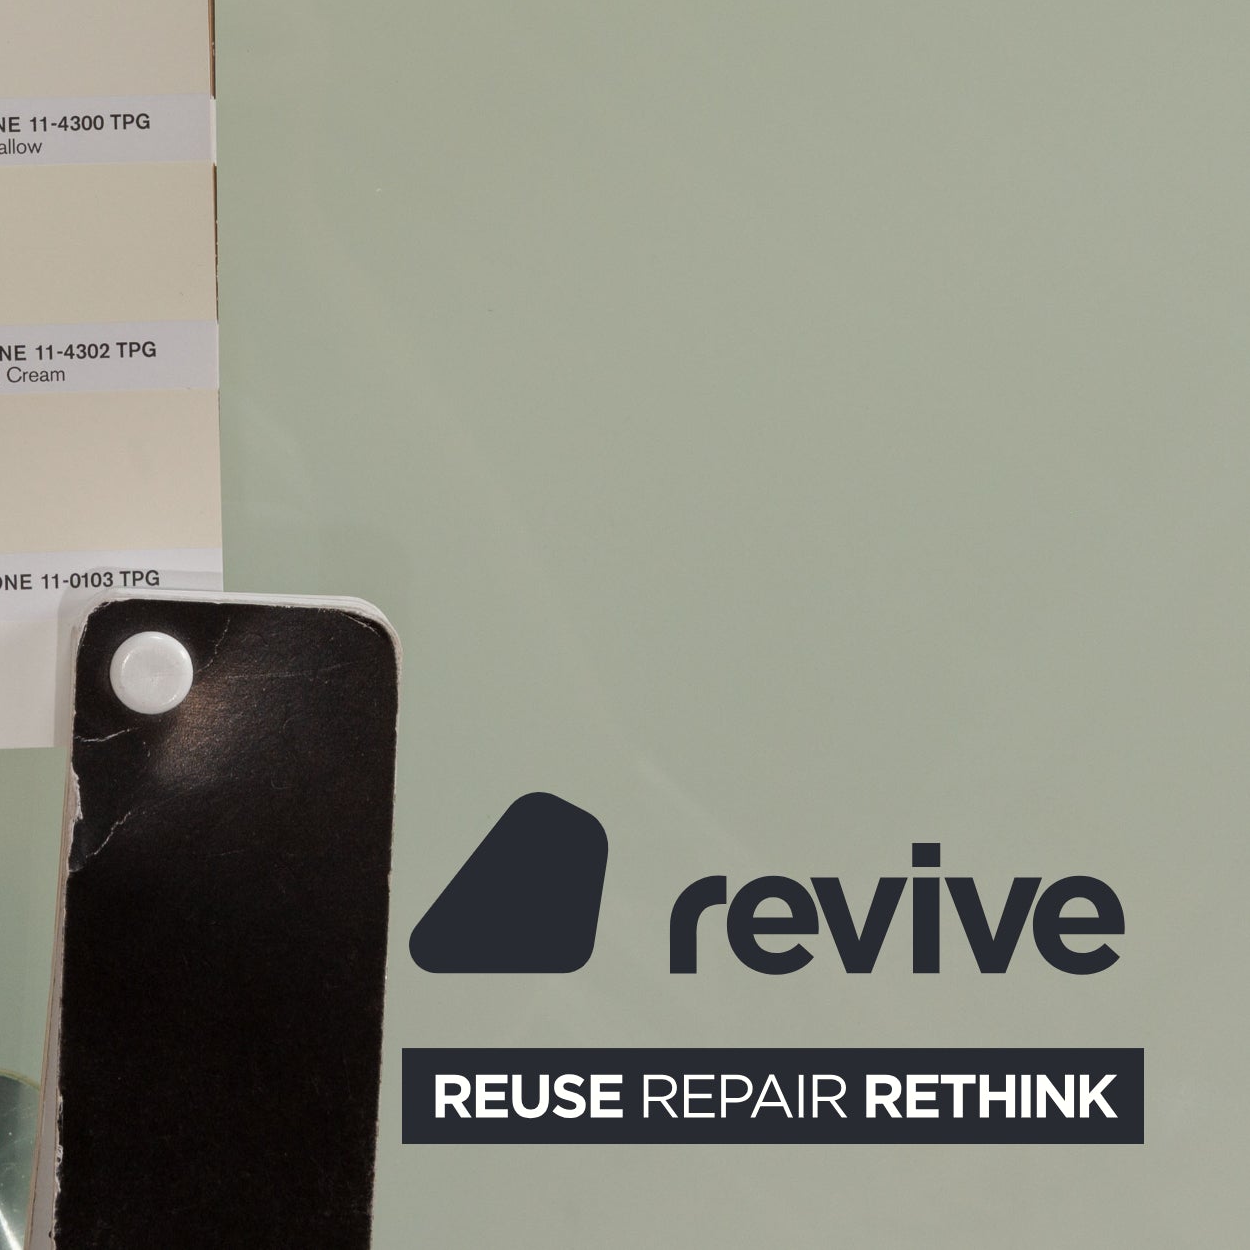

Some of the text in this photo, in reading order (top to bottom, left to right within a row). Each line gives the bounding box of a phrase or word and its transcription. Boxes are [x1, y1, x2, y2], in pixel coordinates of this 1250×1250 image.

[29, 114, 105, 133] 11-4300
[109, 112, 151, 131] TPG
[35, 342, 111, 361] 11-4302
[115, 340, 157, 359] TPG
[5, 366, 66, 384] Cream
[41, 571, 114, 590] 11-0103
[118, 569, 160, 588] TPG
